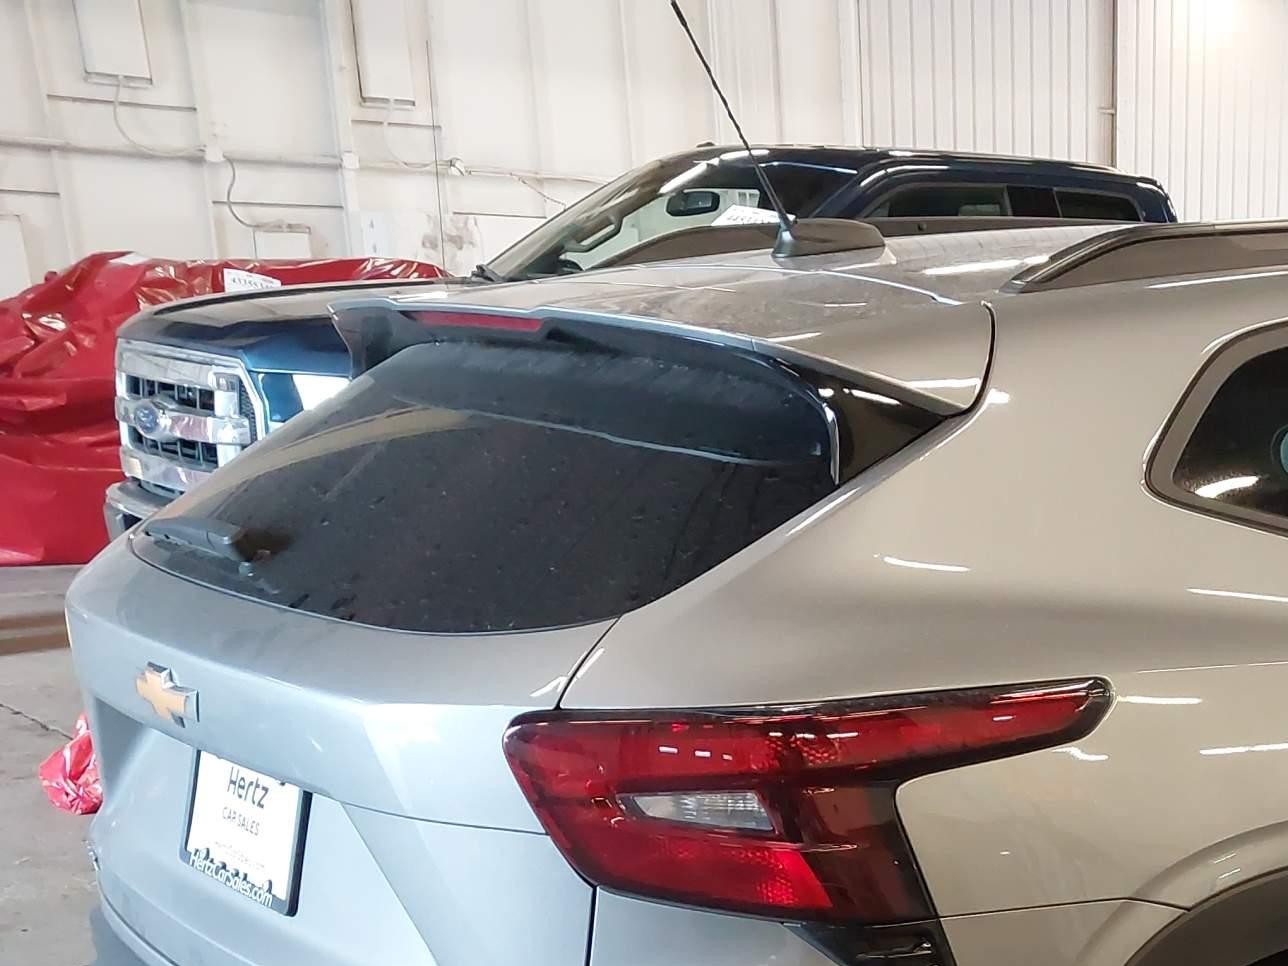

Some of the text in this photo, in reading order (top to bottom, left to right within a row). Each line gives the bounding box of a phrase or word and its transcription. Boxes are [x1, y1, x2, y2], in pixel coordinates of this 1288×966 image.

[227, 766, 269, 808] Hertz
[238, 813, 260, 836] SALES
[189, 848, 273, 907] HertzCarSales.com
